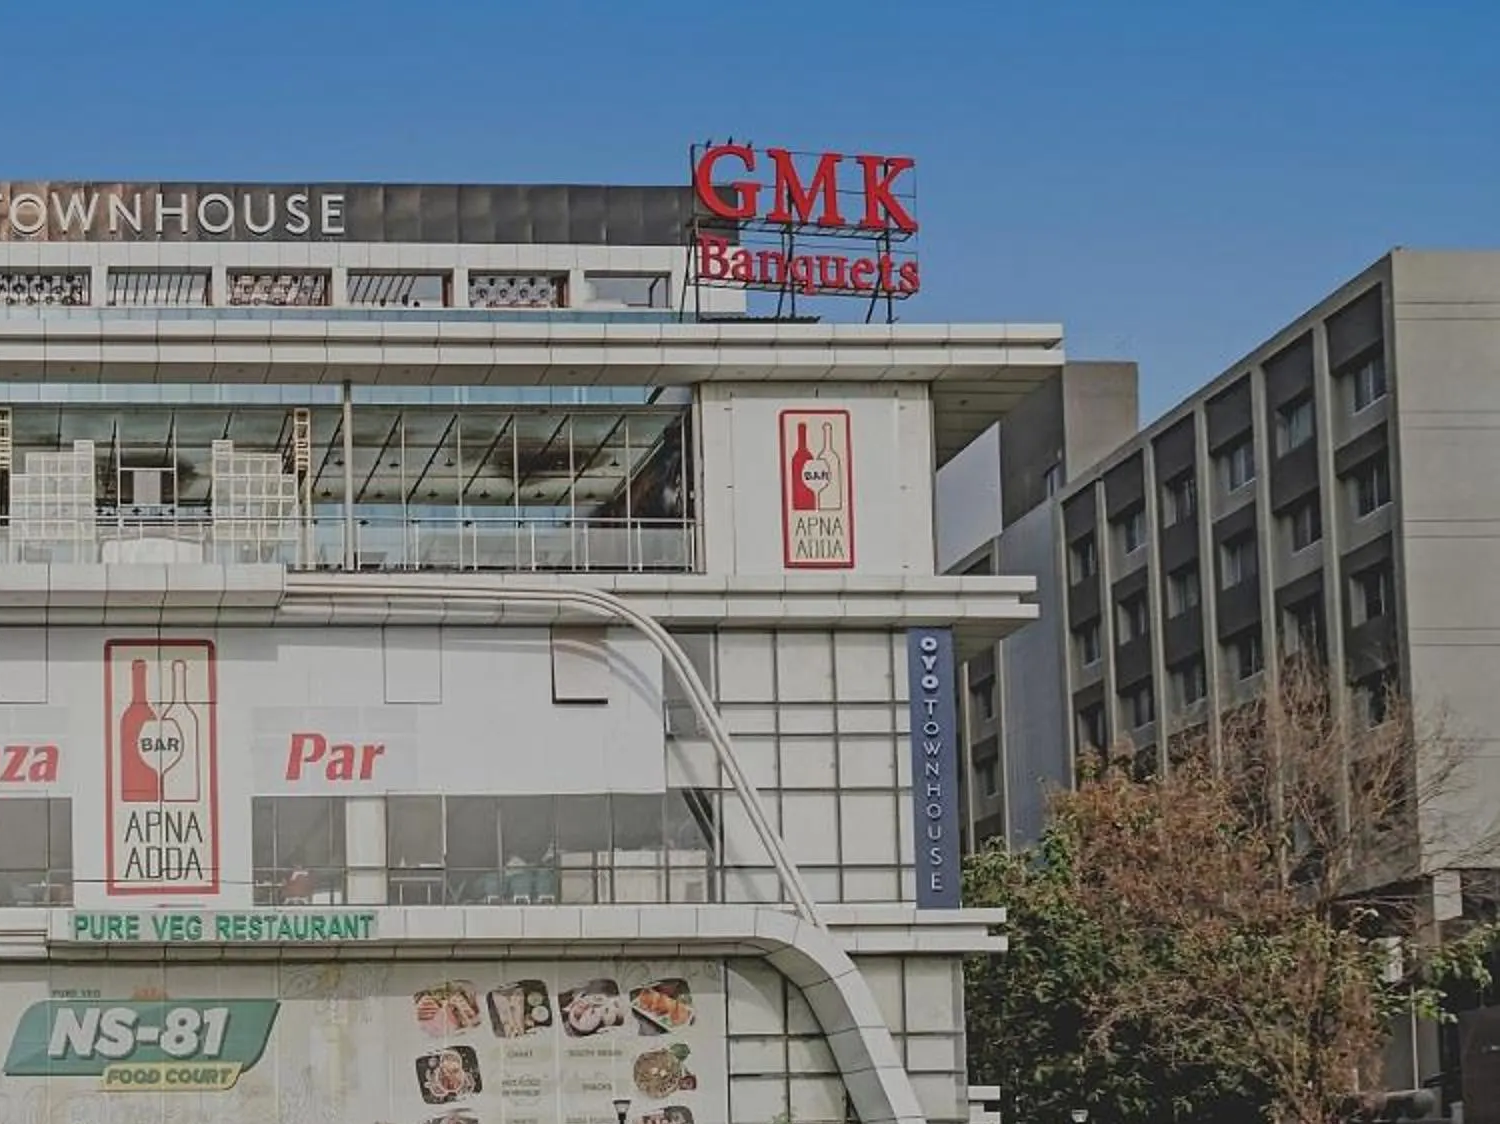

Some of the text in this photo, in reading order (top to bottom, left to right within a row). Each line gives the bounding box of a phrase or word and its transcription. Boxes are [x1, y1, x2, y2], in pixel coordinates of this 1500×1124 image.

[695, 144, 918, 232] GMK
[697, 233, 921, 296] Banquets
[795, 515, 844, 537] APNA
[140, 737, 180, 752] BAR
[285, 733, 386, 781] Par
[920, 636, 944, 890] OYO TOWNHOUSE
[124, 810, 203, 843] APNA
[124, 846, 203, 881] ADDA
[74, 914, 375, 941] PURE VEG RESTAURANT
[47, 1006, 230, 1060] NS-81
[106, 1067, 233, 1085] FOOD COURT
